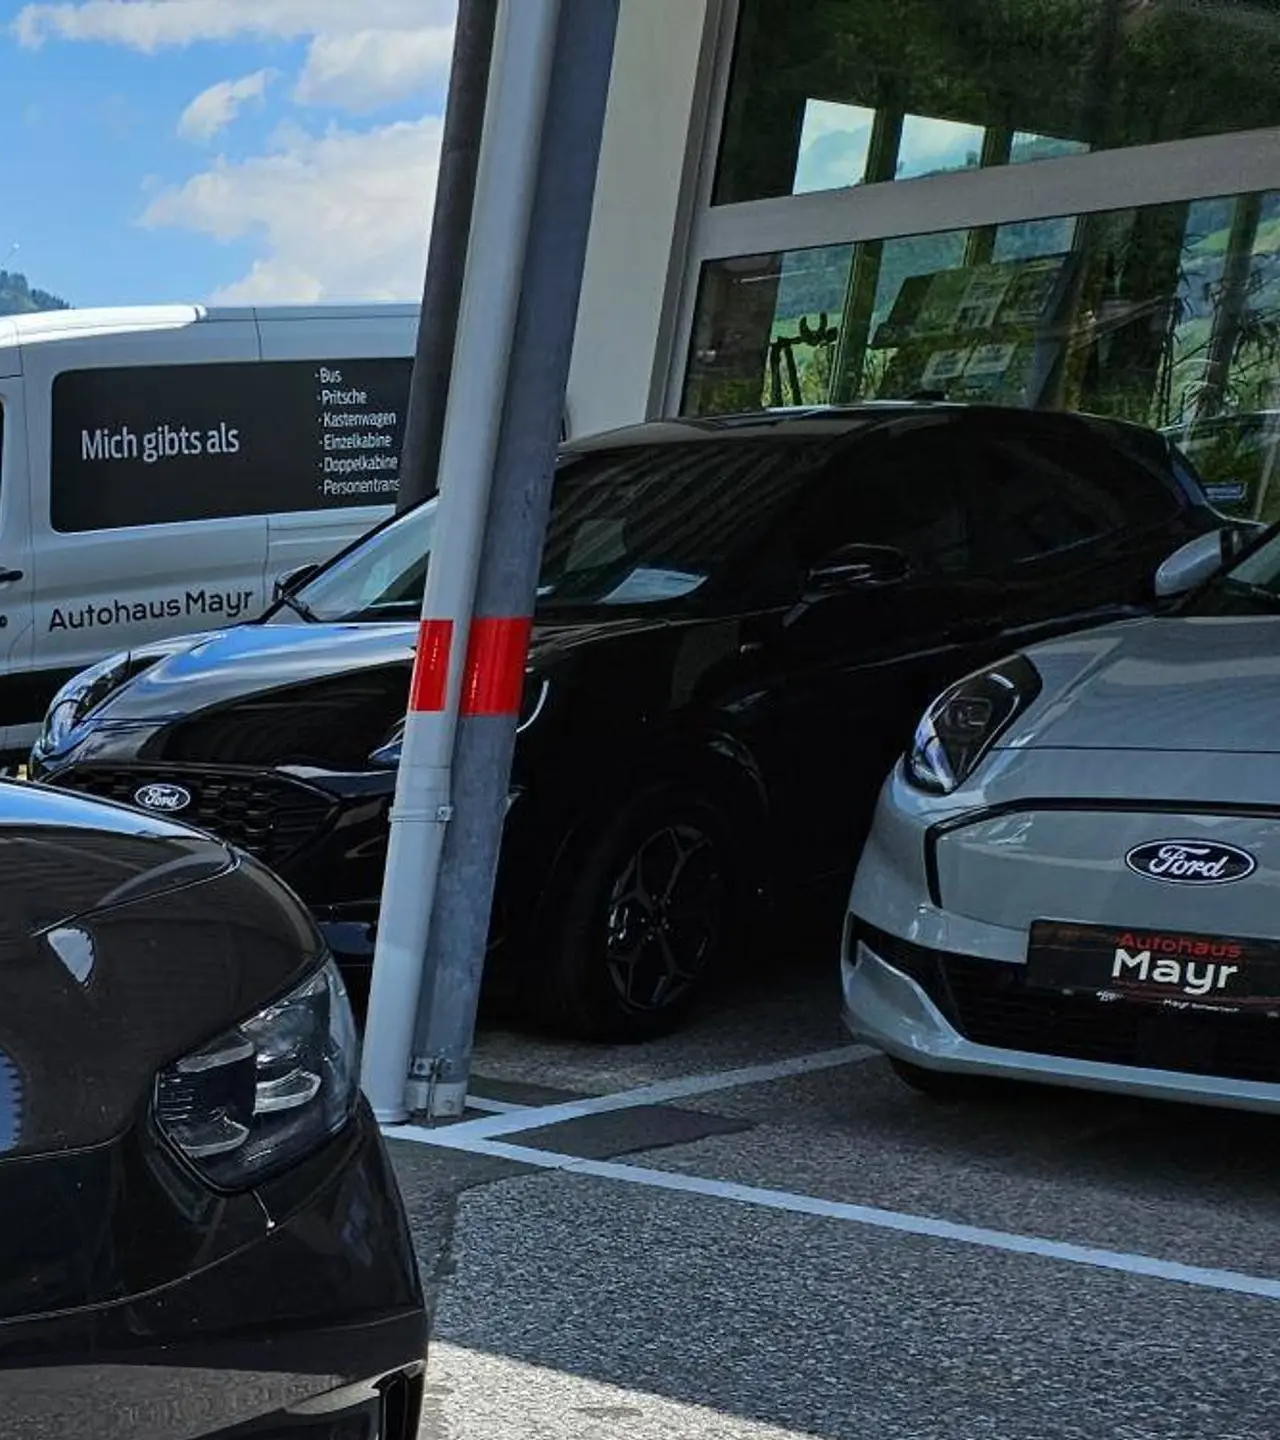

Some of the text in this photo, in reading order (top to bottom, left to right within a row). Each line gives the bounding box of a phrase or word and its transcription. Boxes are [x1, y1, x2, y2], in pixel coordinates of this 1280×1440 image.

[320, 367, 342, 383] Bus
[322, 388, 367, 405] Pritsche
[323, 411, 397, 428] Kastenwagen
[81, 422, 239, 463] Mich gibts als
[323, 431, 393, 450] Einzelkabine
[323, 454, 399, 475] Doppelkabine
[49, 590, 253, 632] Autohaus Mayr
[1116, 933, 1243, 957] Autohaus
[1111, 948, 1238, 995] Mayr
